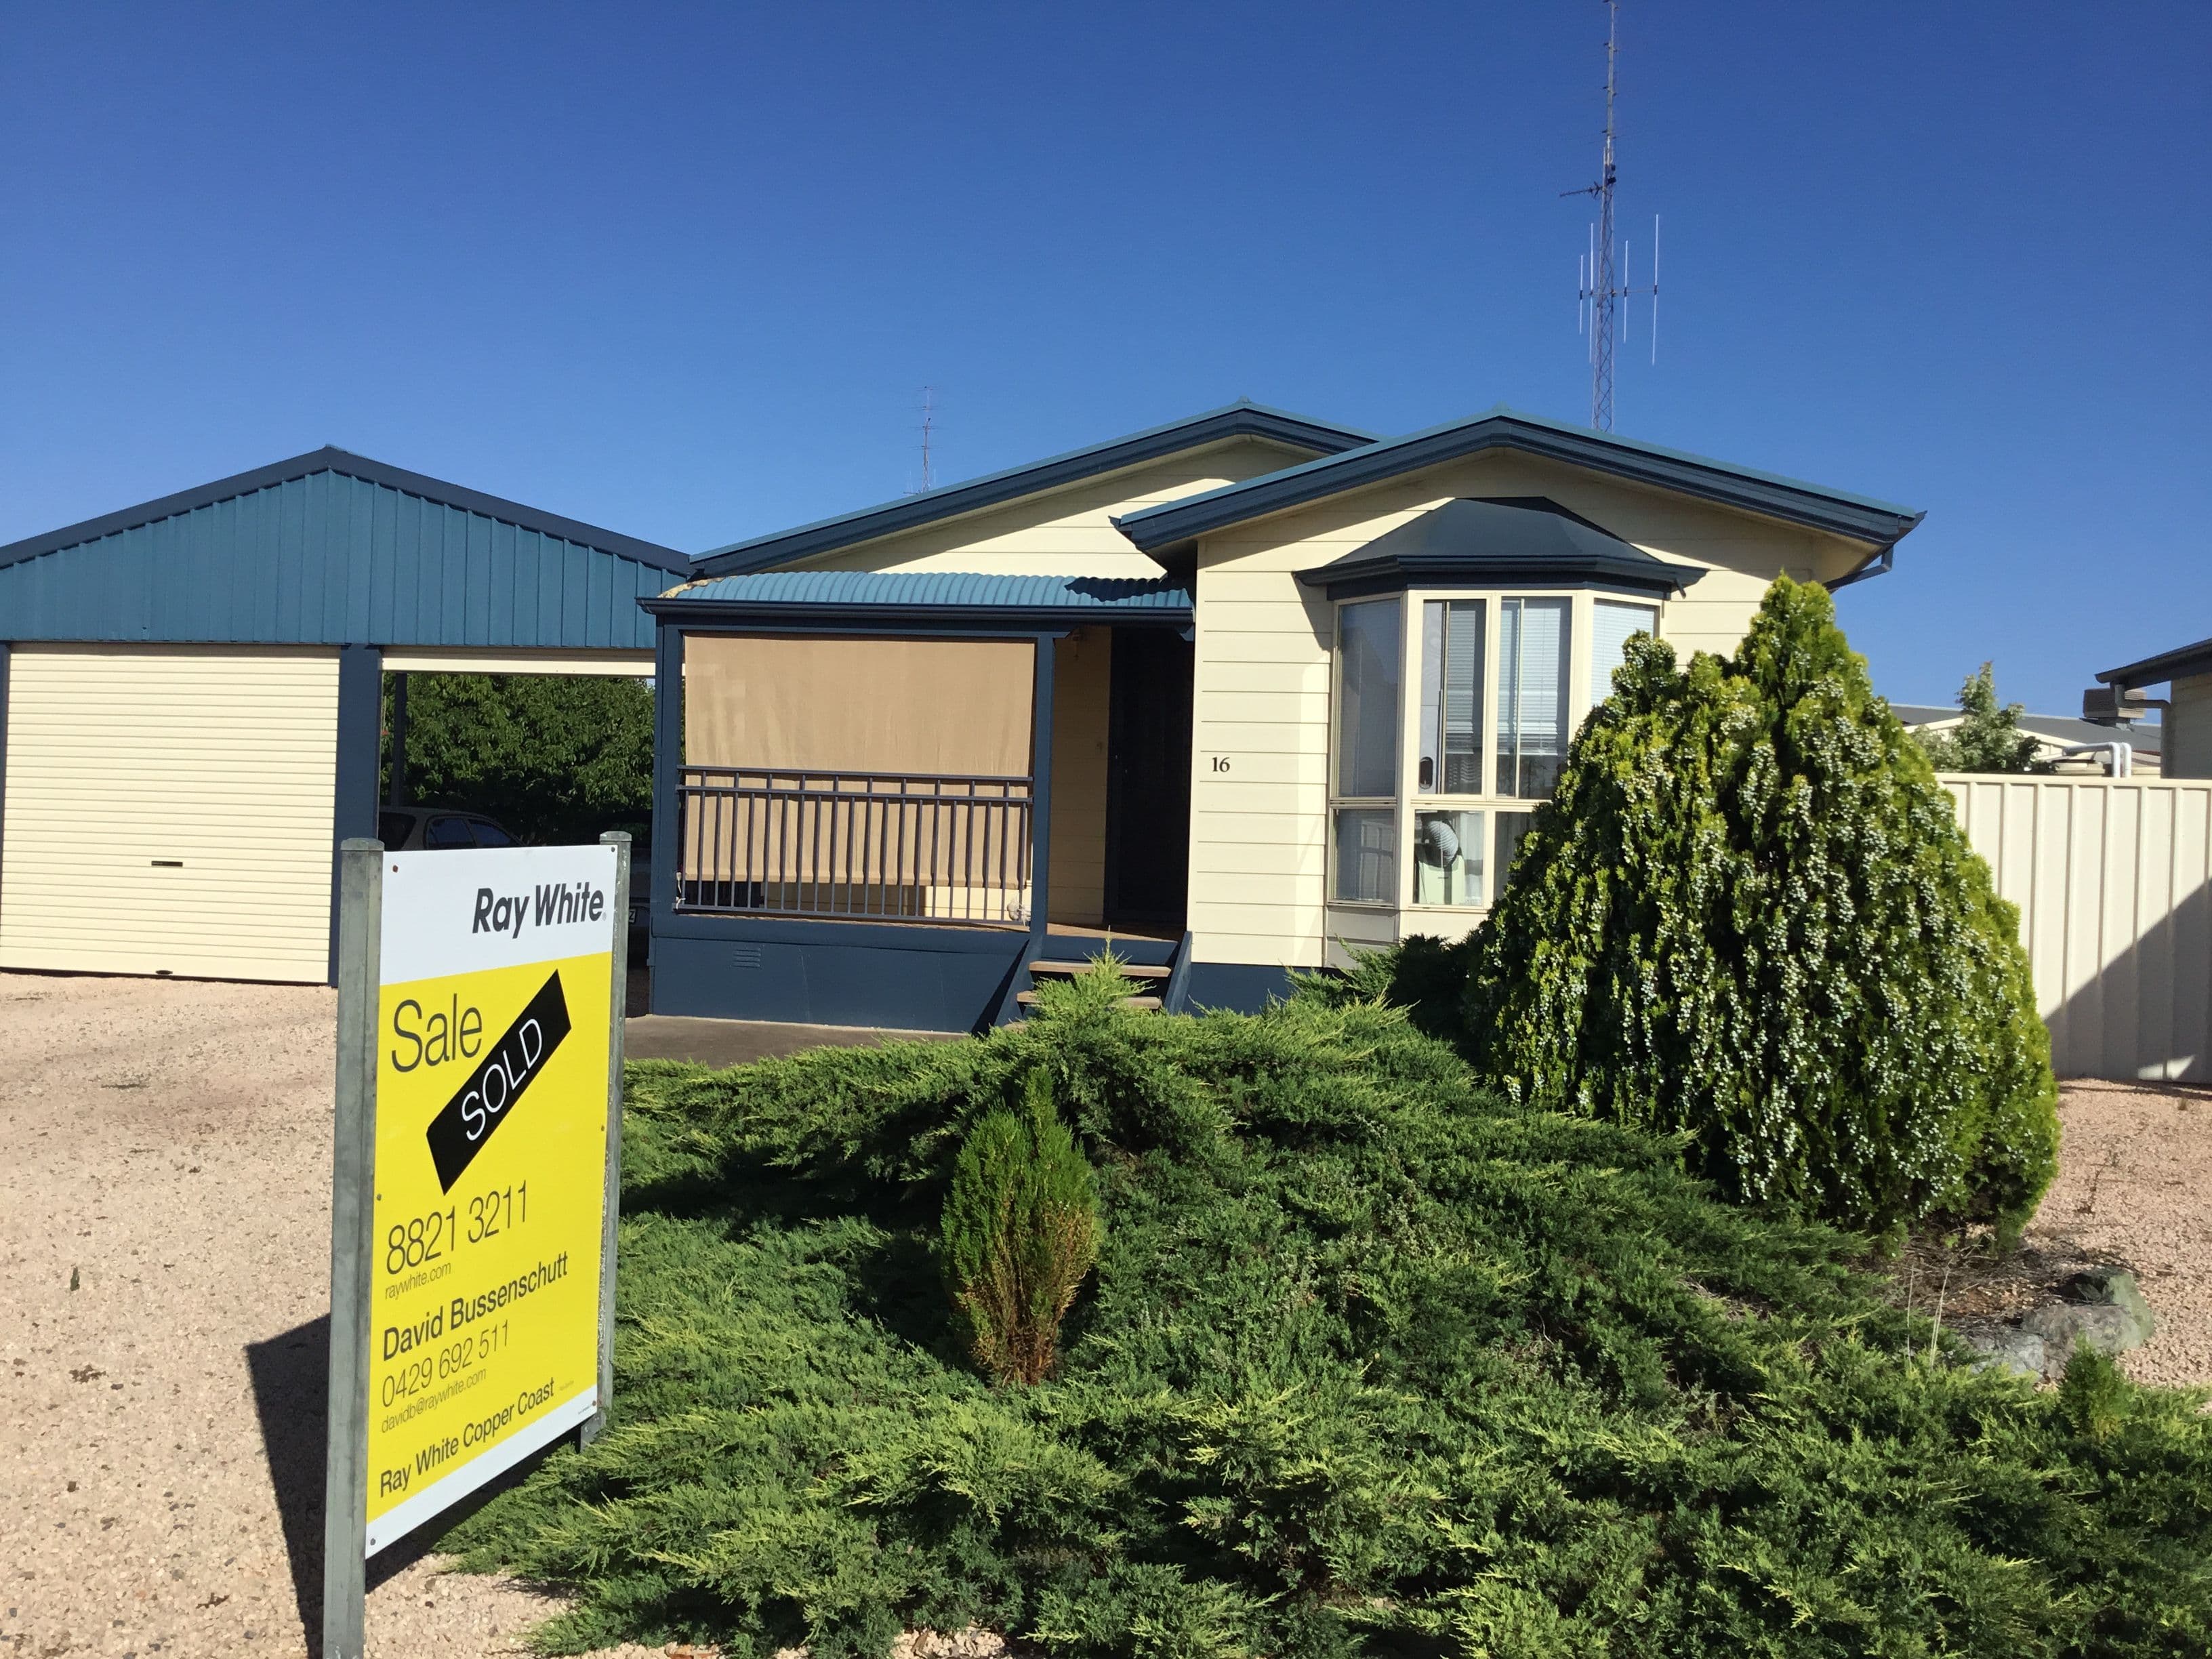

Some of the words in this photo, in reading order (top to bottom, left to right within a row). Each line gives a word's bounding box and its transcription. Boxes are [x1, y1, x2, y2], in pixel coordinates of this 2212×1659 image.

[1212, 756, 1231, 773] 16
[472, 887, 529, 939] Ray
[535, 882, 604, 926] White
[392, 994, 483, 1073] Sale
[462, 1019, 542, 1141] SOLD
[386, 1206, 455, 1275] 8821
[468, 1180, 527, 1244] 3211
[383, 1306, 443, 1361] David
[450, 1251, 568, 1330] Bussenschutt
[385, 1262, 452, 1300] raywhite.com
[382, 1358, 432, 1408] 0429
[439, 1337, 473, 1380] 692
[479, 1319, 509, 1359] 511
[382, 1367, 485, 1433] davidb@raywhite.com
[380, 1464, 411, 1498] Ray
[416, 1435, 458, 1476] White
[463, 1404, 515, 1447] Copper
[517, 1376, 554, 1414] Coast
